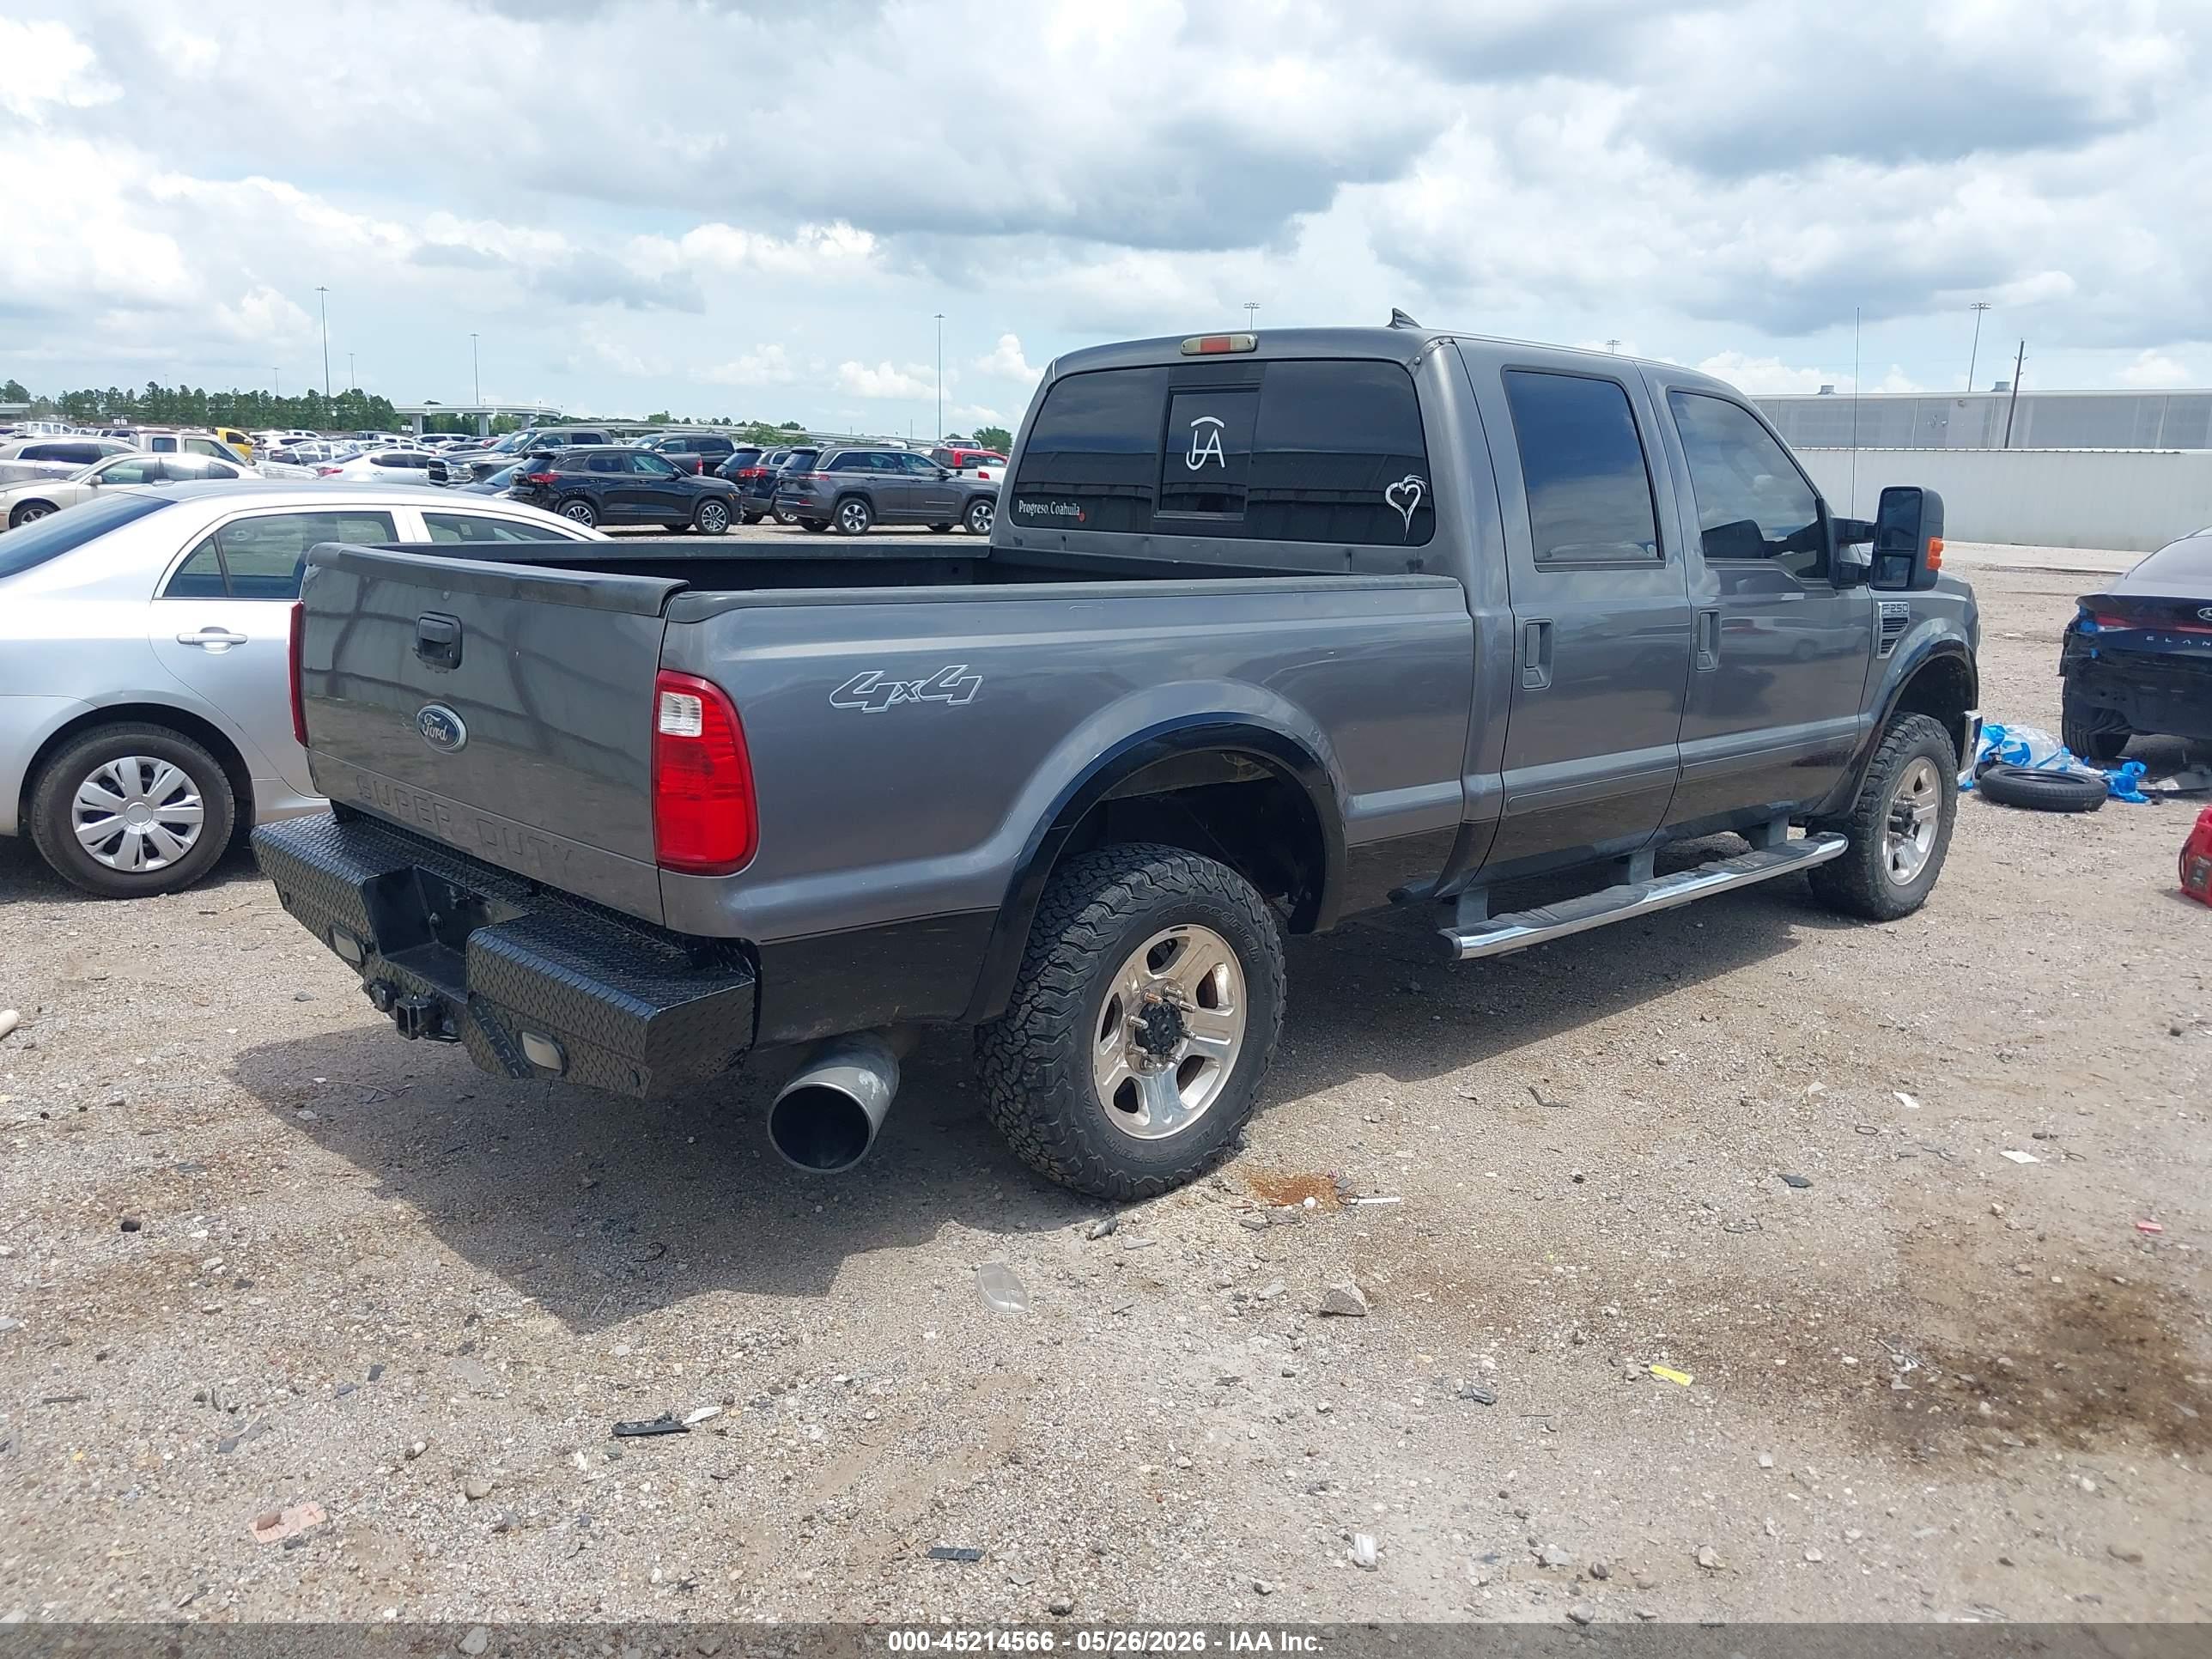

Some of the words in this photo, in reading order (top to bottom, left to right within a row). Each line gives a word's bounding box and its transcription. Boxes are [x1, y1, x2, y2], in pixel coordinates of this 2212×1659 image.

[1050, 501, 1079, 515] Coahuila
[829, 664, 983, 714] 4x4
[422, 713, 447, 741] Ford
[356, 775, 455, 838] SUPER
[477, 817, 572, 878] DUTY
